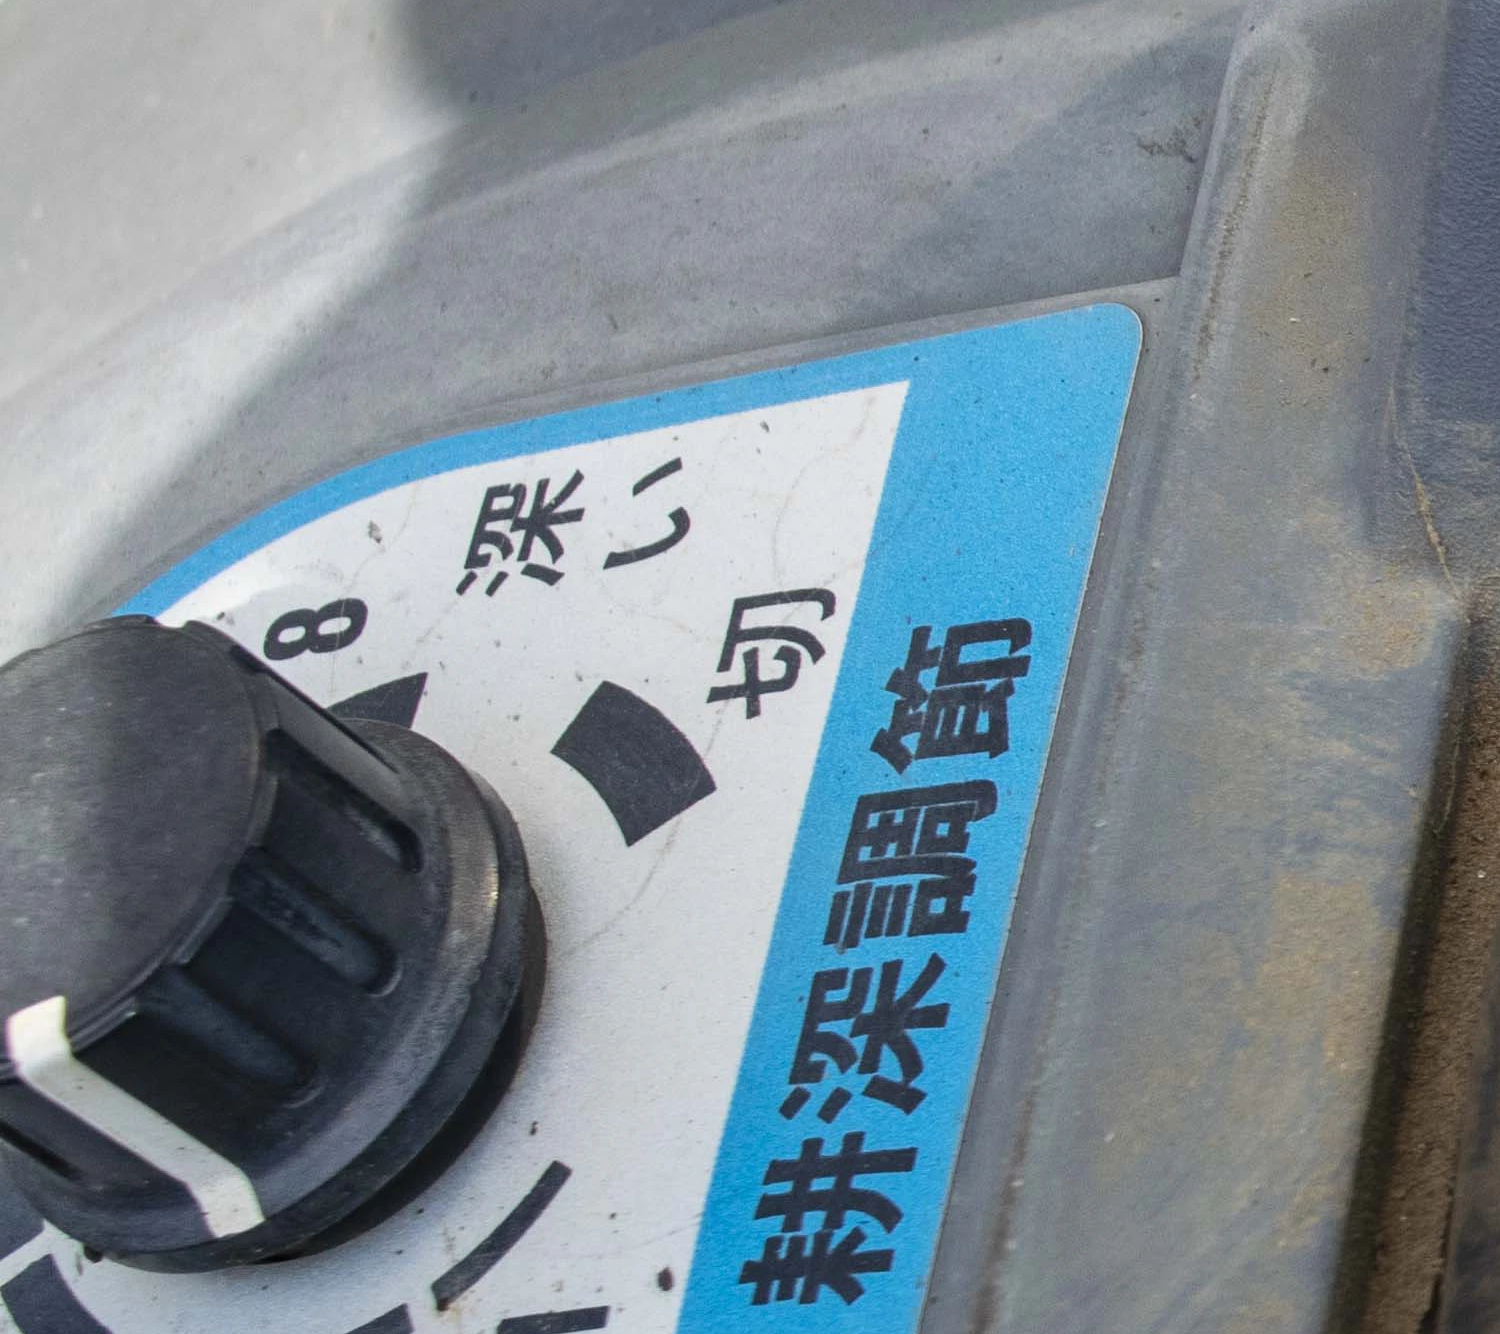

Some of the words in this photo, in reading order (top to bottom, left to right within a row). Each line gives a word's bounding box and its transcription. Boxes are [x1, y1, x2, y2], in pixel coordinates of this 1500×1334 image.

[456, 457, 684, 599] 深い
[263, 598, 368, 663] 8
[707, 587, 838, 719] 切
[739, 615, 1033, 1308] 耕深調節
